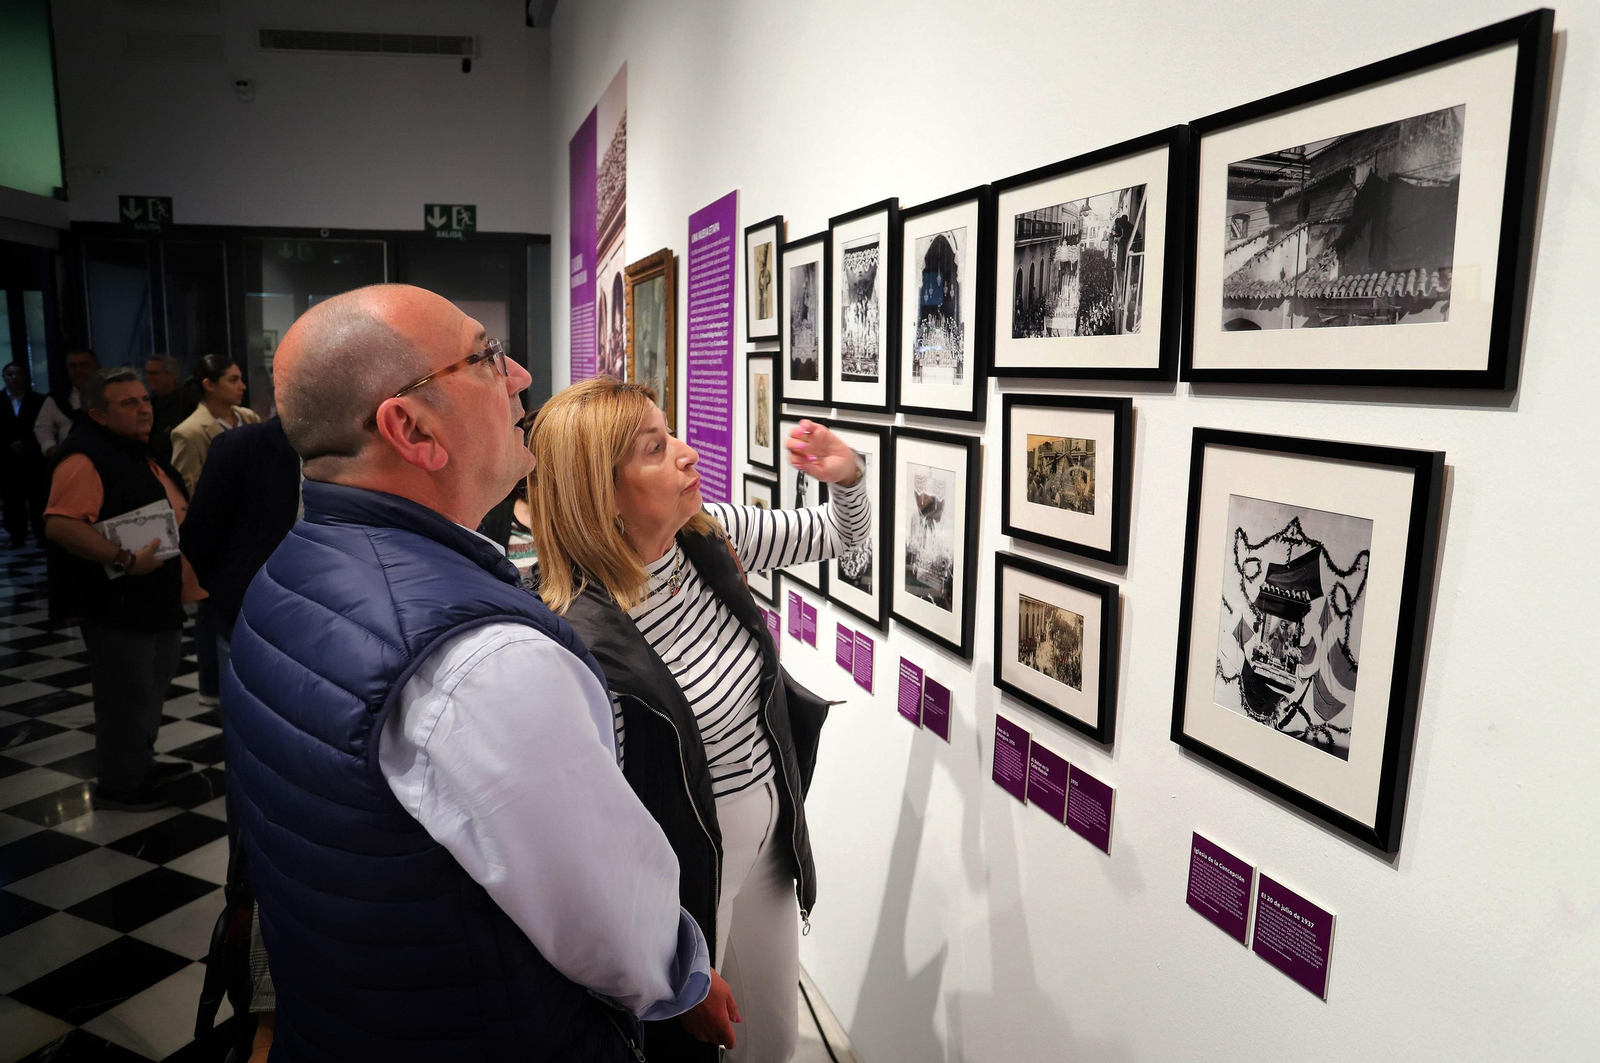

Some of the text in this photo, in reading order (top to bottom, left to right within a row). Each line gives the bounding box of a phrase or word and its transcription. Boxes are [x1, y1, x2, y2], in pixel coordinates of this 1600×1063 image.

[1194, 847, 1207, 859] Iglesia
[1219, 863, 1245, 882] Concepción
[1280, 904, 1293, 915] julio
[1301, 917, 1314, 928] 1937
